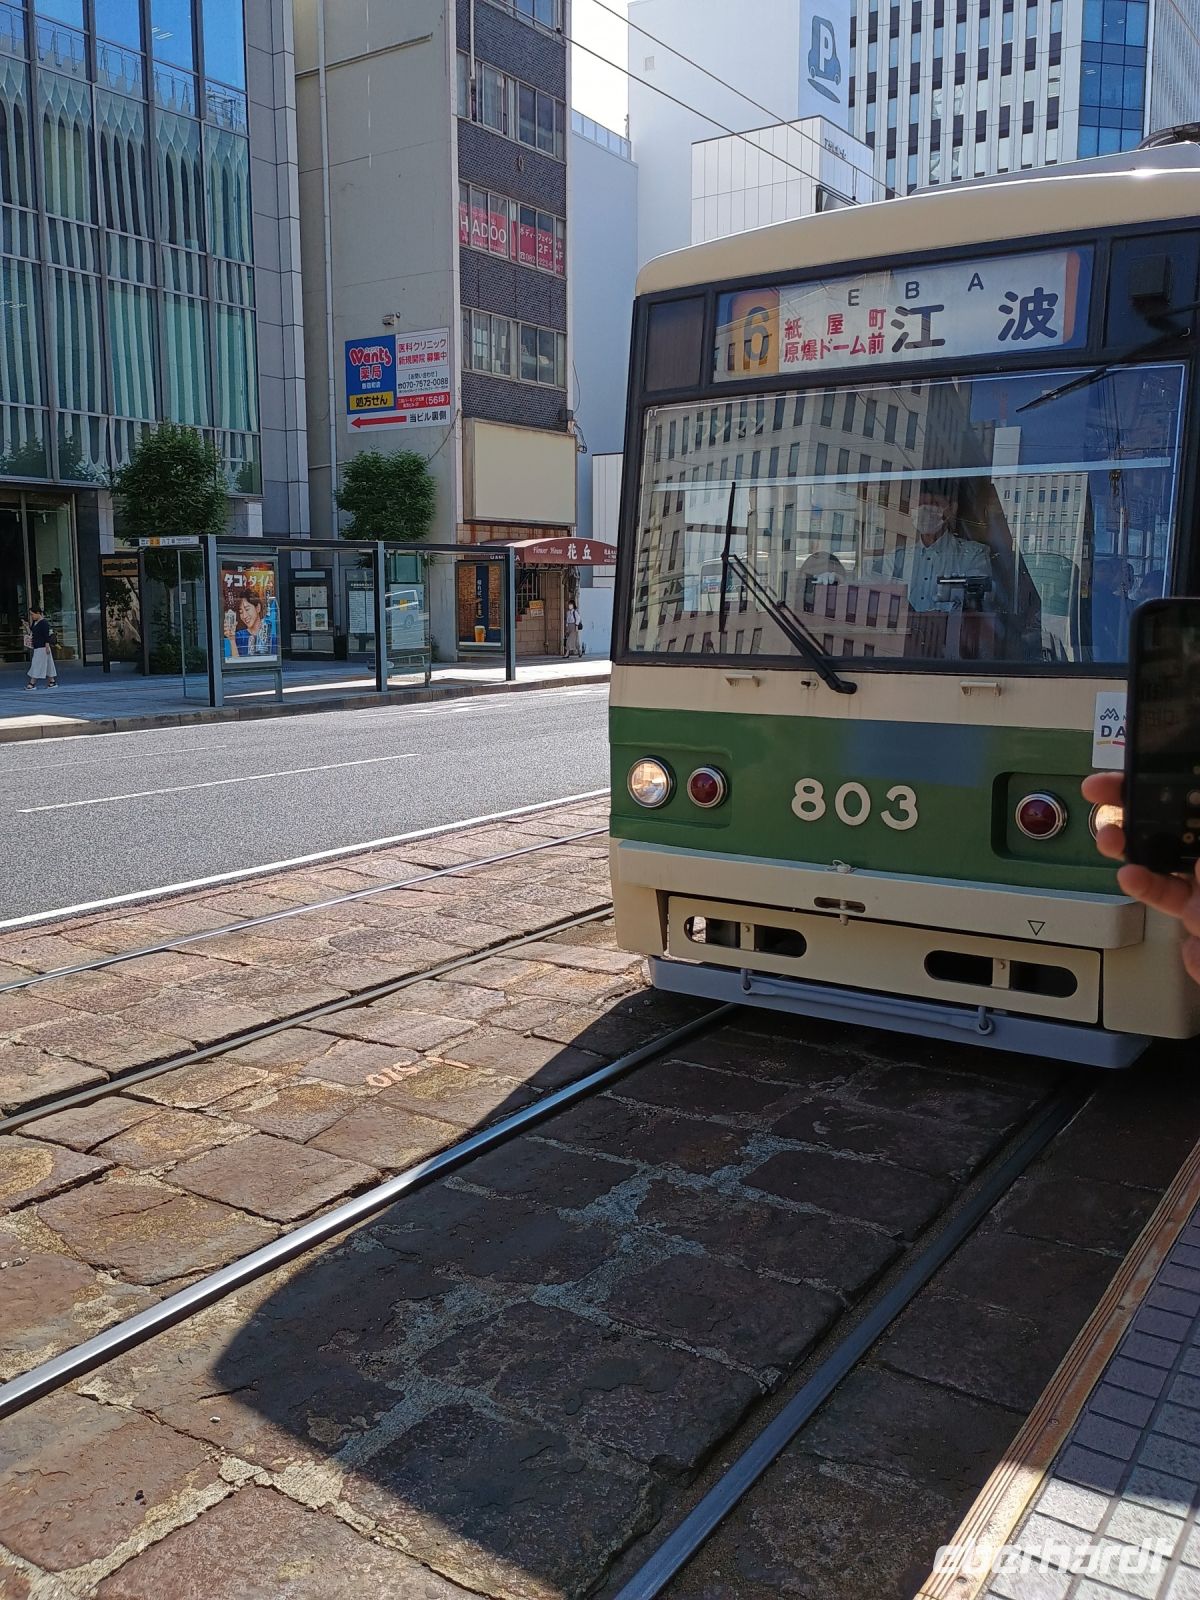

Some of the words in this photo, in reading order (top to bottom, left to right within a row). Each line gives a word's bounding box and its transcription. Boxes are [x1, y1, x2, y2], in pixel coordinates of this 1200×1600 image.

[784, 309, 887, 340] 紙屋町
[891, 287, 1059, 353] 江波
[744, 306, 769, 361] 6
[350, 346, 392, 366] Wants
[399, 339, 447, 354] 医科クリニック
[784, 332, 885, 363] 原爆ドーム前
[360, 364, 382, 381] 薬局
[355, 395, 388, 408] 処方せん
[409, 410, 447, 423] 当ビル裏側
[533, 546, 548, 554] Flower
[549, 546, 563, 555] House
[567, 543, 592, 561] 花丘
[791, 777, 919, 831] 803
